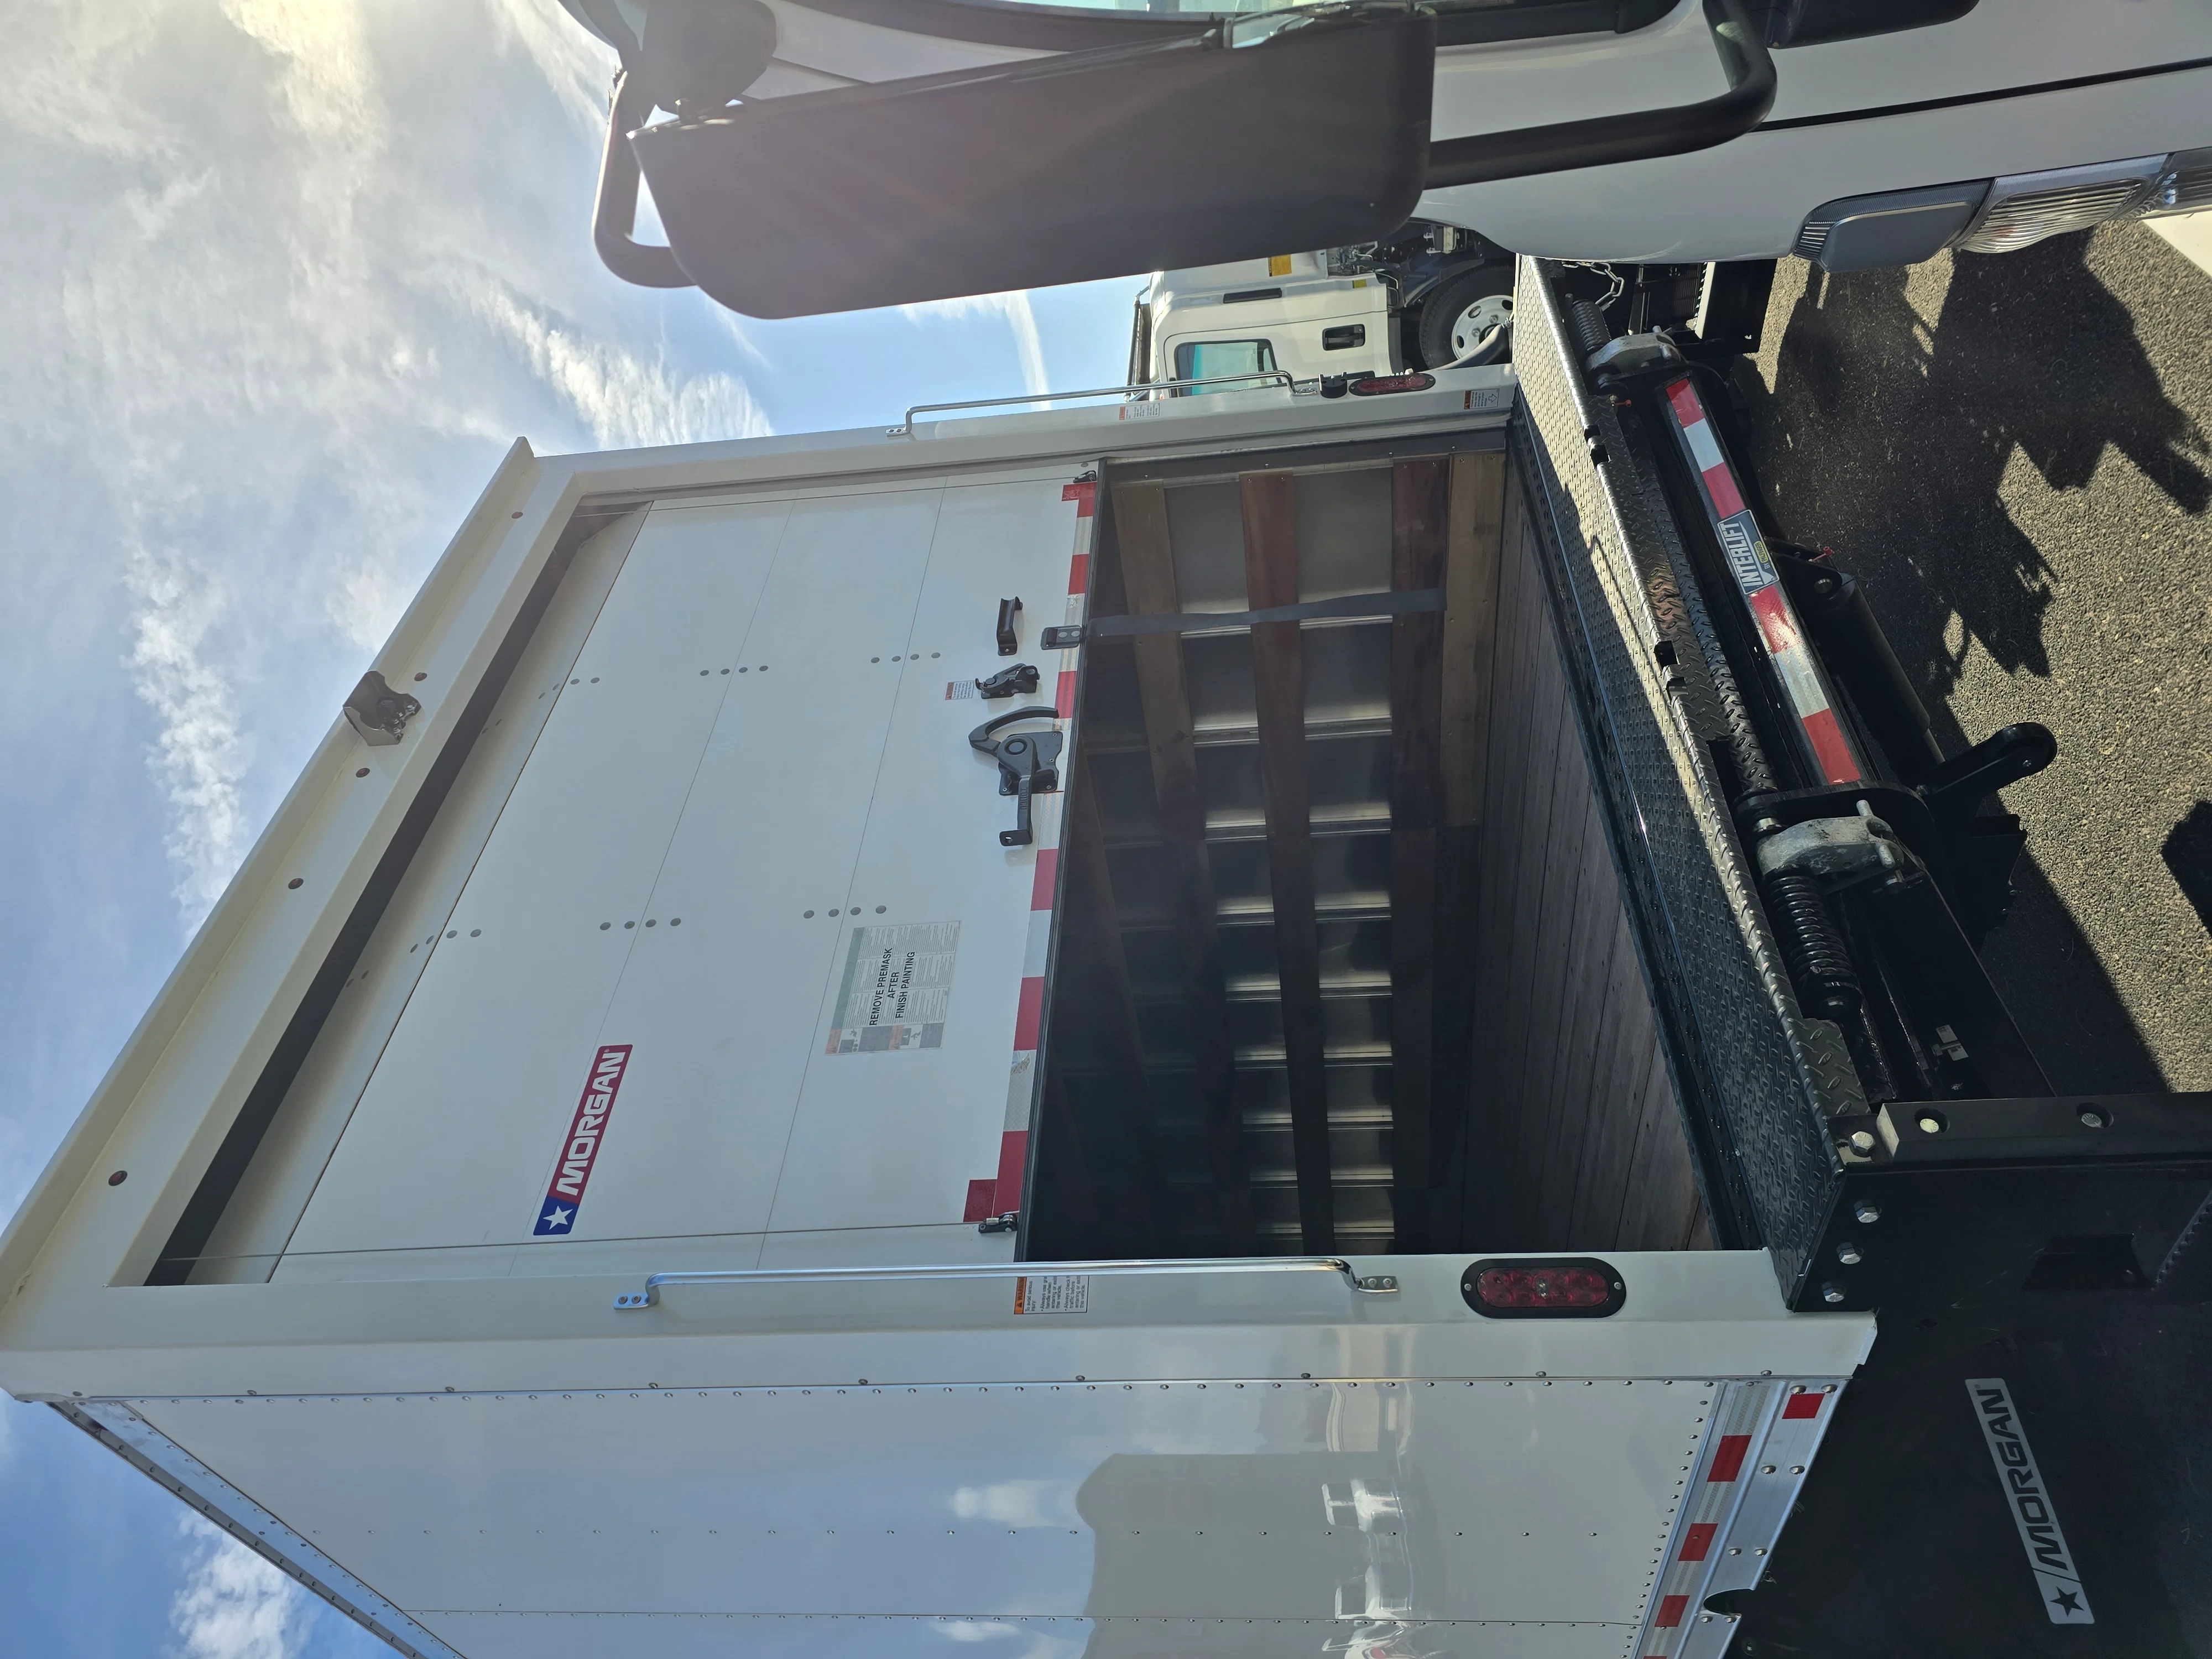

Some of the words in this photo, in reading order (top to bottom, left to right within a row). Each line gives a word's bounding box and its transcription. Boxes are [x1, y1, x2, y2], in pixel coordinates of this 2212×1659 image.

[1719, 523, 1764, 587] INTERLIFT
[1755, 542, 1767, 562] PALFINGER
[869, 990, 884, 1025] REMOVE
[877, 948, 893, 988] PREMASK
[887, 972, 900, 998] AFTER
[901, 951, 915, 989] PAINTING
[895, 992, 908, 1018] FINISH
[556, 1051, 626, 1196] MORGAN
[1976, 1388, 2069, 1571] MORGAN
